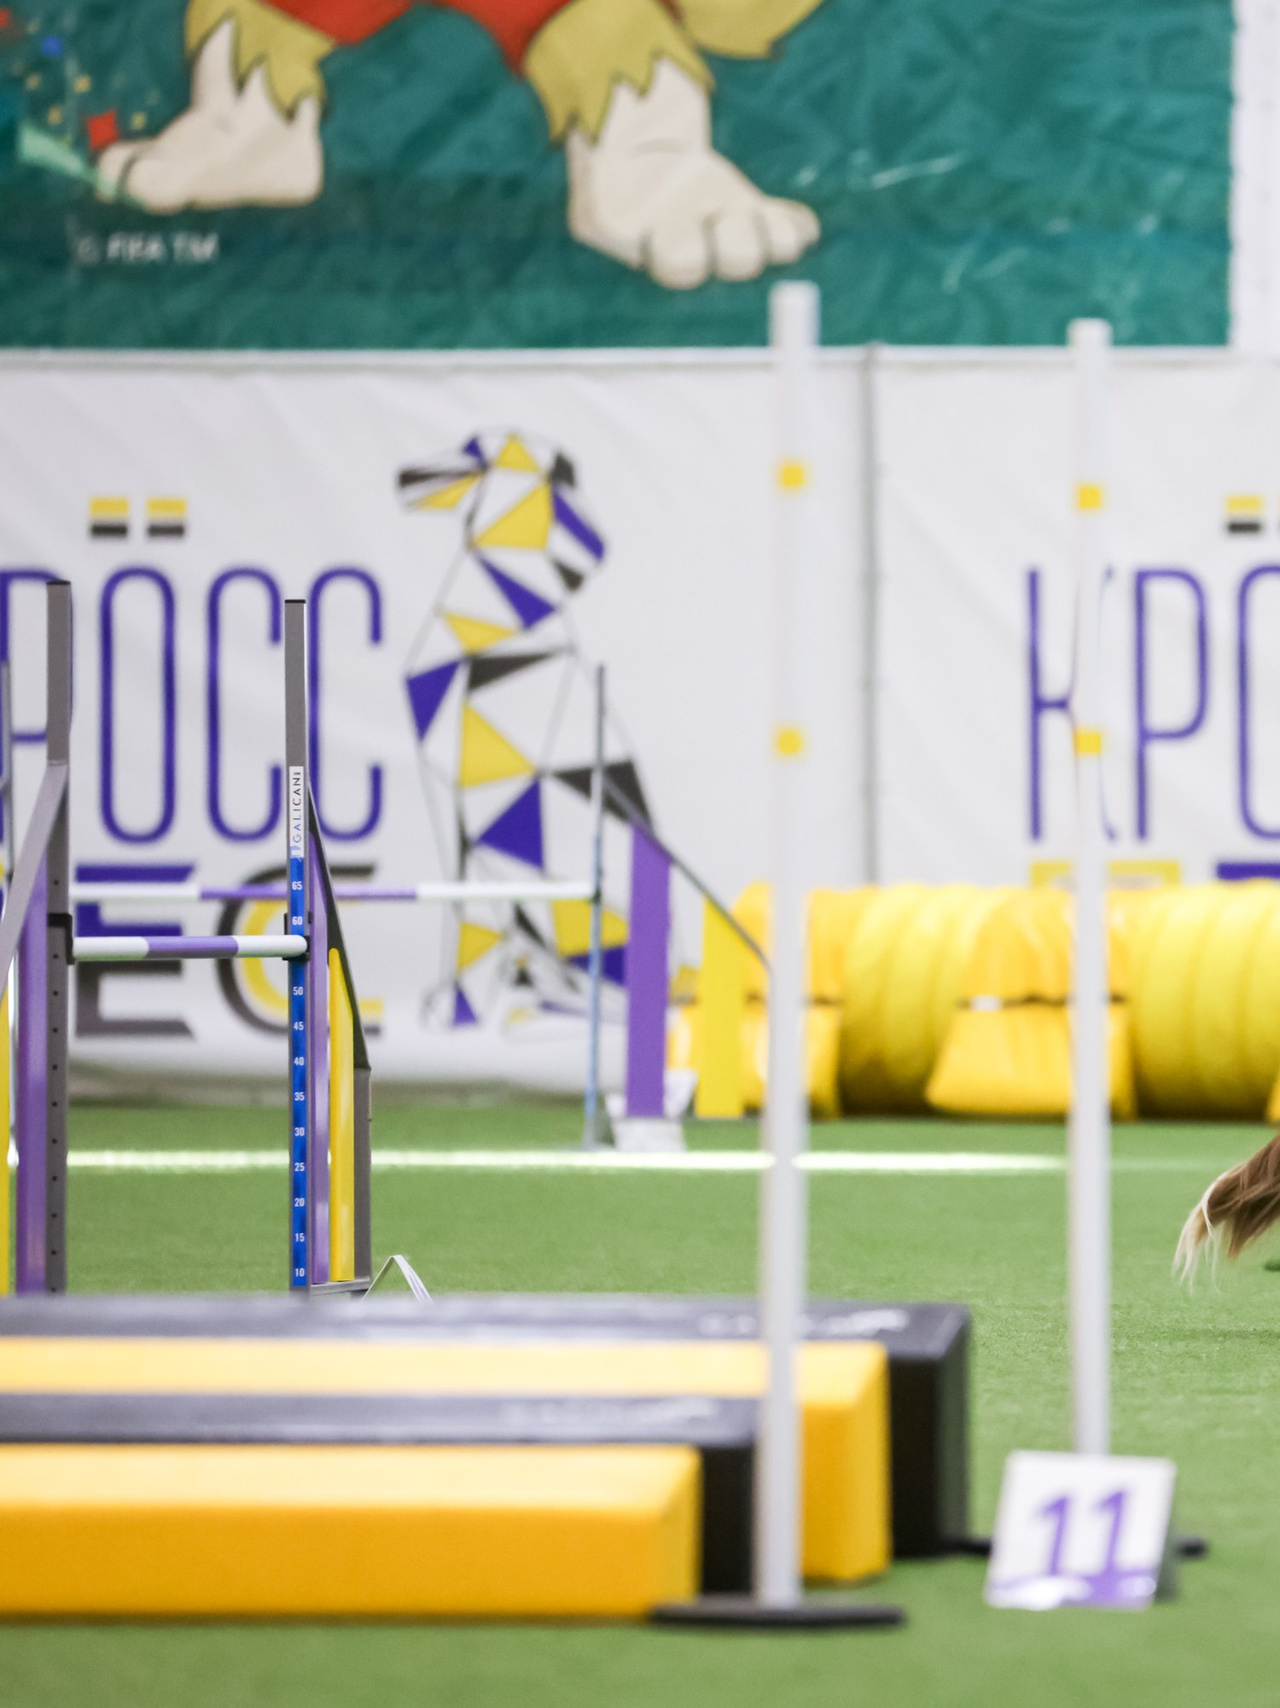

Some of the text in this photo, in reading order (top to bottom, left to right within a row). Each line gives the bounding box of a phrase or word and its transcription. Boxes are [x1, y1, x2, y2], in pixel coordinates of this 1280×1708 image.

[107, 232, 167, 263] FIFA
[291, 881, 303, 891] 65
[291, 916, 303, 926] 60
[292, 986, 304, 996] 50
[293, 1021, 304, 1031] 45
[293, 1056, 305, 1066] 40
[294, 1091, 305, 1102] 35
[294, 1127, 305, 1137] 30
[294, 1162, 305, 1172] 25
[294, 1197, 305, 1207] 20
[294, 1232, 305, 1242] 15
[294, 1267, 305, 1278] 10
[1038, 1489, 1130, 1577] 11
